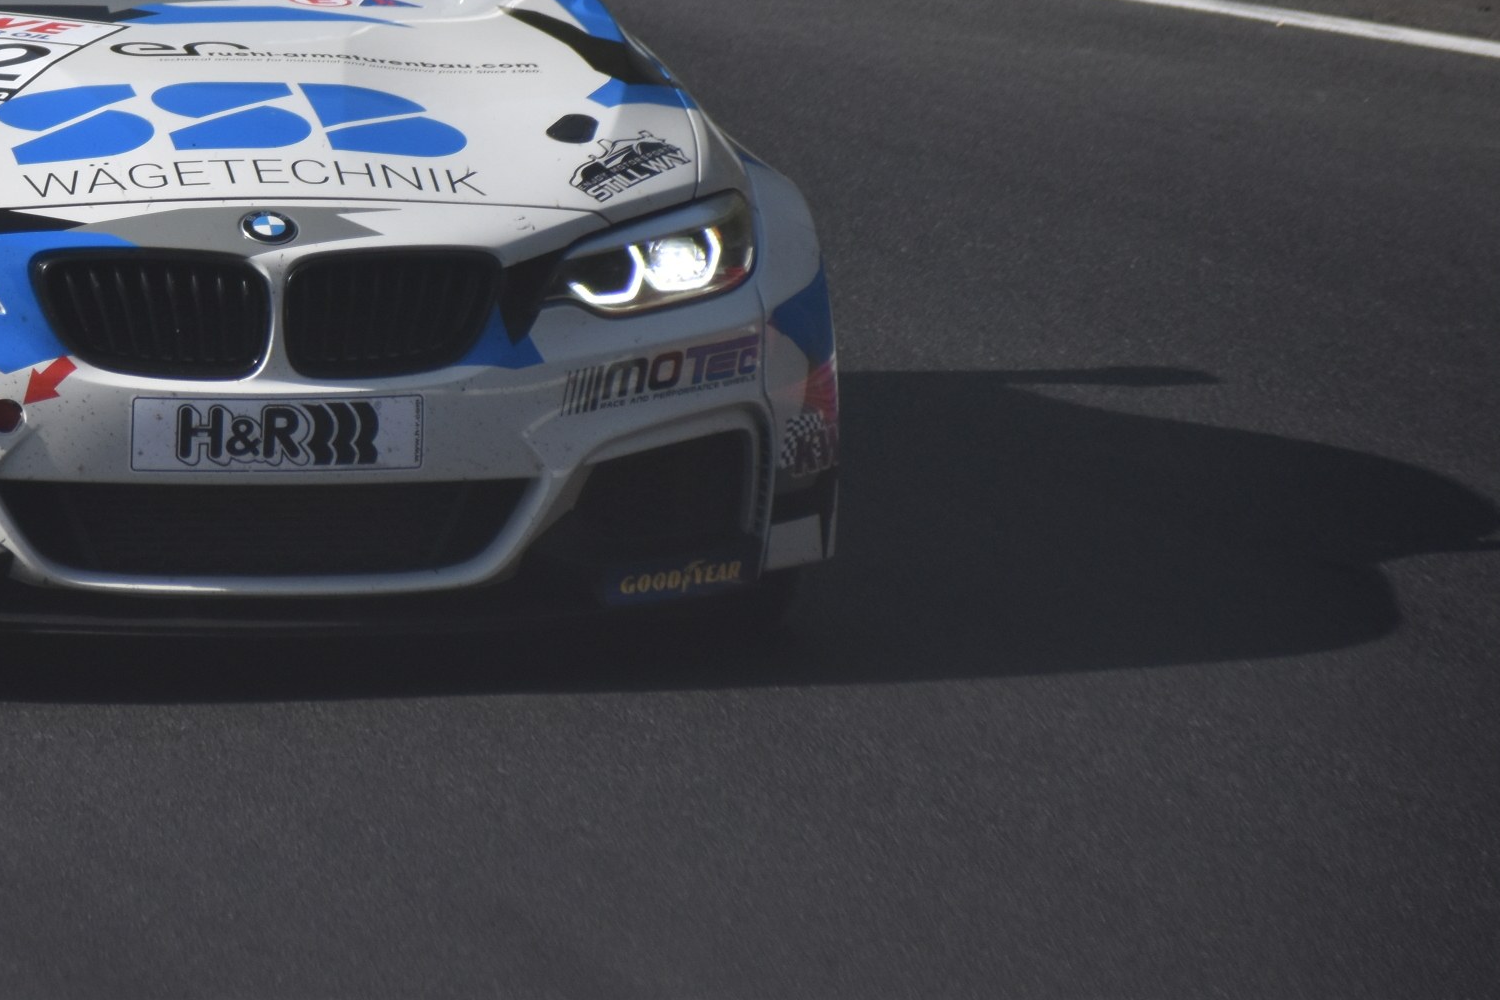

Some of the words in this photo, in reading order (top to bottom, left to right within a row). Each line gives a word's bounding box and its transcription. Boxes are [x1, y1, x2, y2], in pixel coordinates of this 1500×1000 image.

[11, 30, 52, 41] OIL
[207, 50, 540, 69] ruehl-armaturenbau.com
[22, 158, 488, 198] WÄGETECHNIK
[577, 172, 608, 191] ENJOY
[585, 168, 651, 202] STILL
[643, 149, 692, 174] WAY
[653, 383, 720, 400] PERFORMANCE
[176, 403, 311, 467] H&R
